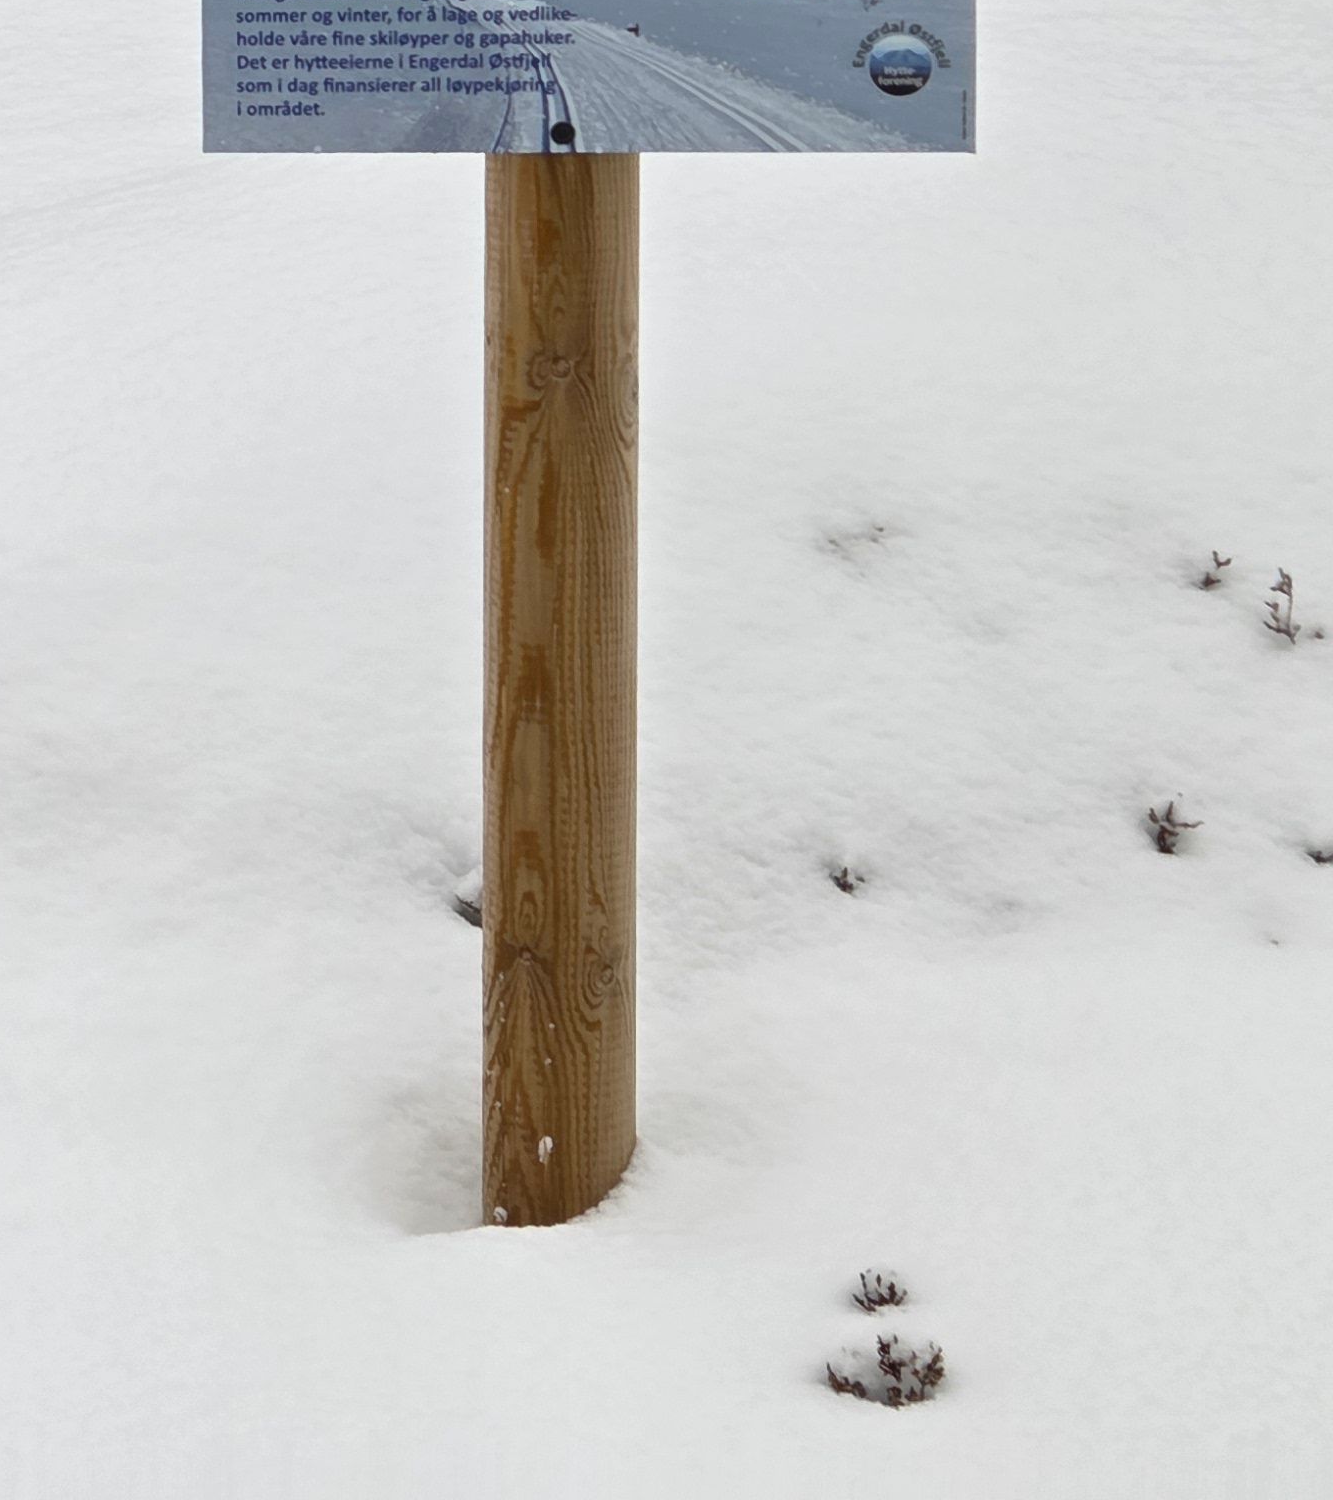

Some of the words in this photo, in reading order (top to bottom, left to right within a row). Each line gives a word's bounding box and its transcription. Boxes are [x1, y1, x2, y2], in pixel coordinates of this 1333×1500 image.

[236, 11, 307, 24] sommer
[312, 11, 333, 26] og
[337, 8, 392, 25] vinter,
[397, 7, 421, 23] for
[427, 7, 437, 22] å
[442, 7, 477, 26] lage
[482, 10, 504, 26] og
[508, 7, 578, 23] vedlike-
[236, 31, 285, 47] holde
[290, 30, 327, 46] våre
[332, 30, 365, 46] fine
[369, 30, 450, 48] skiløyper
[454, 33, 475, 48] og
[479, 31, 576, 49] gapahuker.
[851, 20, 905, 68] Engerdal
[909, 23, 952, 68] Østfjell
[236, 55, 267, 70] Det
[271, 58, 290, 70] er
[398, 55, 404, 69] i
[408, 53, 483, 72] Engerdal
[488, 53, 553, 72] Østfjell
[236, 81, 273, 93] som
[277, 78, 283, 93] i
[287, 77, 319, 97] dag
[323, 77, 416, 93] finansierer
[420, 77, 441, 92] all
[446, 76, 558, 95] løypekjøring
[236, 102, 242, 116] i
[246, 101, 326, 117] området.
